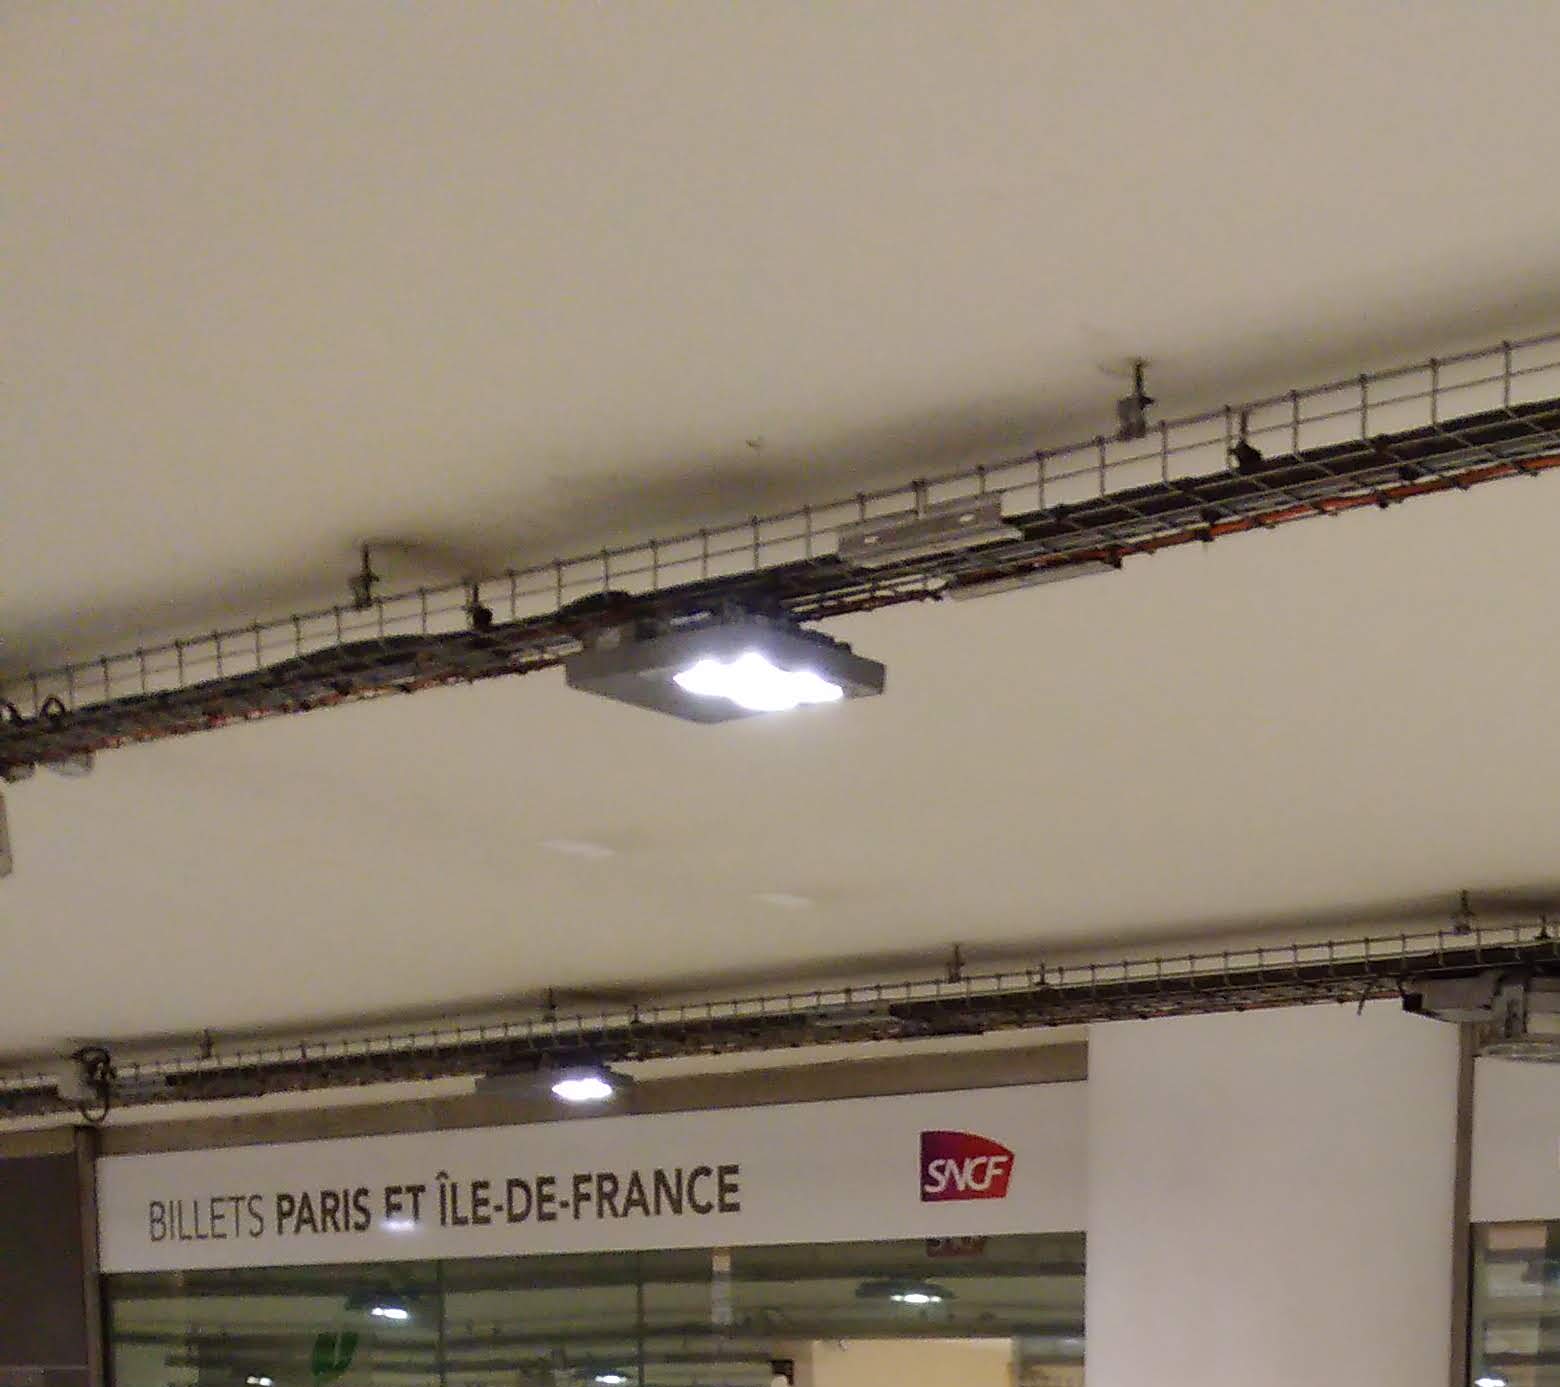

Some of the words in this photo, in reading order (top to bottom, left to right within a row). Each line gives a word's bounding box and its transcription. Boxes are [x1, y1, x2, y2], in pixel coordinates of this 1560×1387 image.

[149, 1194, 264, 1242] BILLETS
[275, 1187, 372, 1235] PARIS
[384, 1184, 427, 1228] ET
[435, 1164, 742, 1227] ÎLE-DE-FRANCE
[923, 1155, 1009, 1193] SNCF
